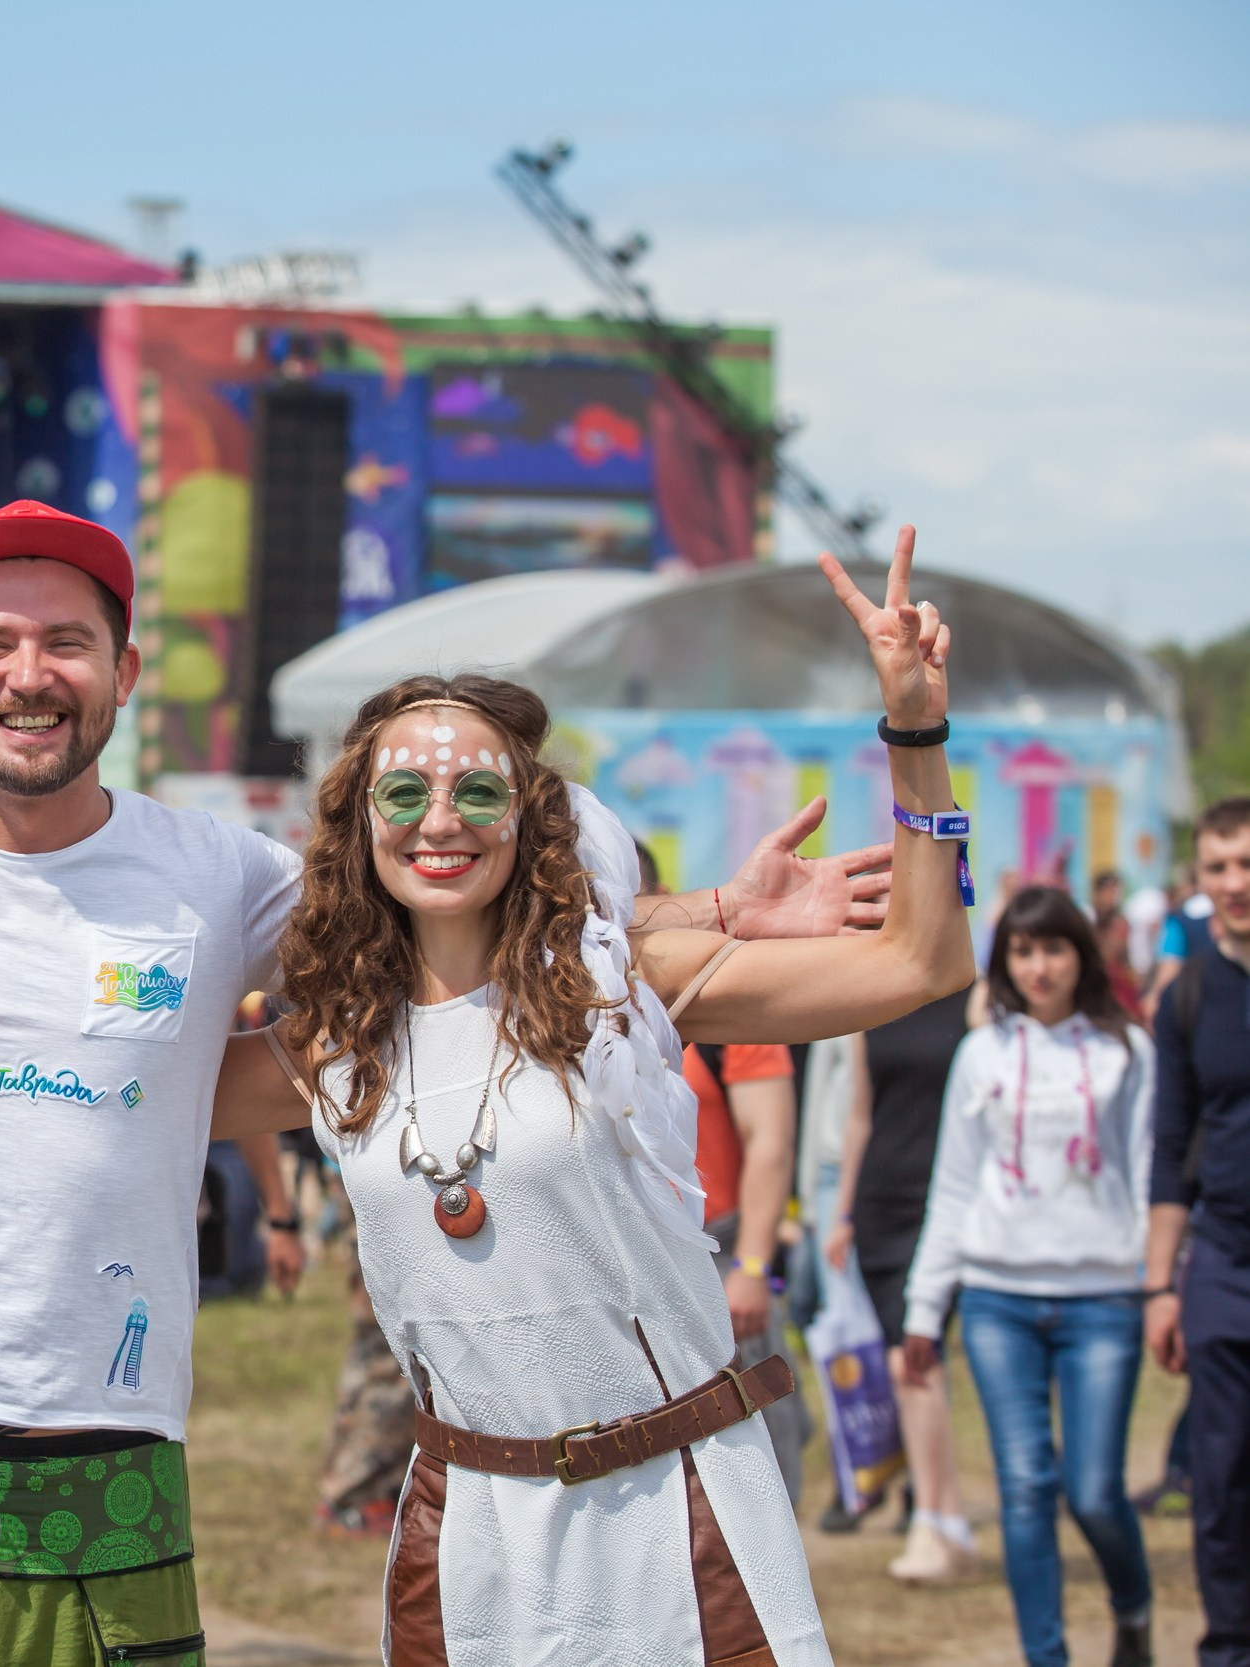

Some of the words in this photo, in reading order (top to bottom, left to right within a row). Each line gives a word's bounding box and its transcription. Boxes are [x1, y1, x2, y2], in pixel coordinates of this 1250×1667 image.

[909, 815, 930, 827] МЯТА
[948, 822, 967, 830] 2018
[960, 868, 968, 888] 2018
[101, 962, 125, 973] 2018
[96, 964, 187, 997] Таврида
